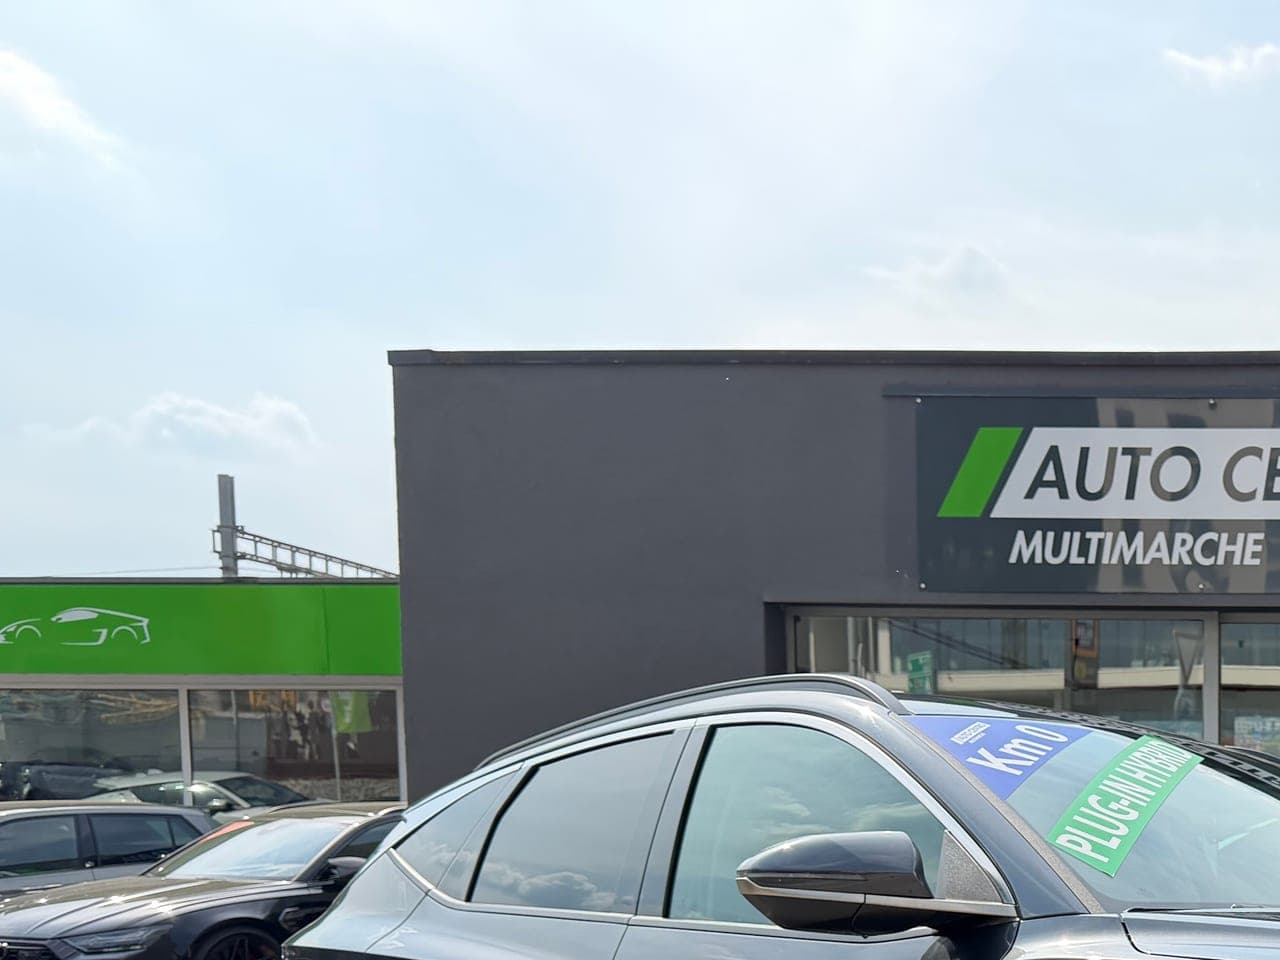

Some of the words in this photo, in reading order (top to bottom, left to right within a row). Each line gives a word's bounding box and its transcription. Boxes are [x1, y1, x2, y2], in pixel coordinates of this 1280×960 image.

[1024, 444, 1201, 501] AUTO
[1008, 529, 1266, 566] MULTIMARCHE
[967, 738, 1054, 777] Km
[1015, 724, 1069, 744] 0
[1055, 771, 1149, 864] PLUG-IN
[1119, 739, 1193, 797] HYBRID
